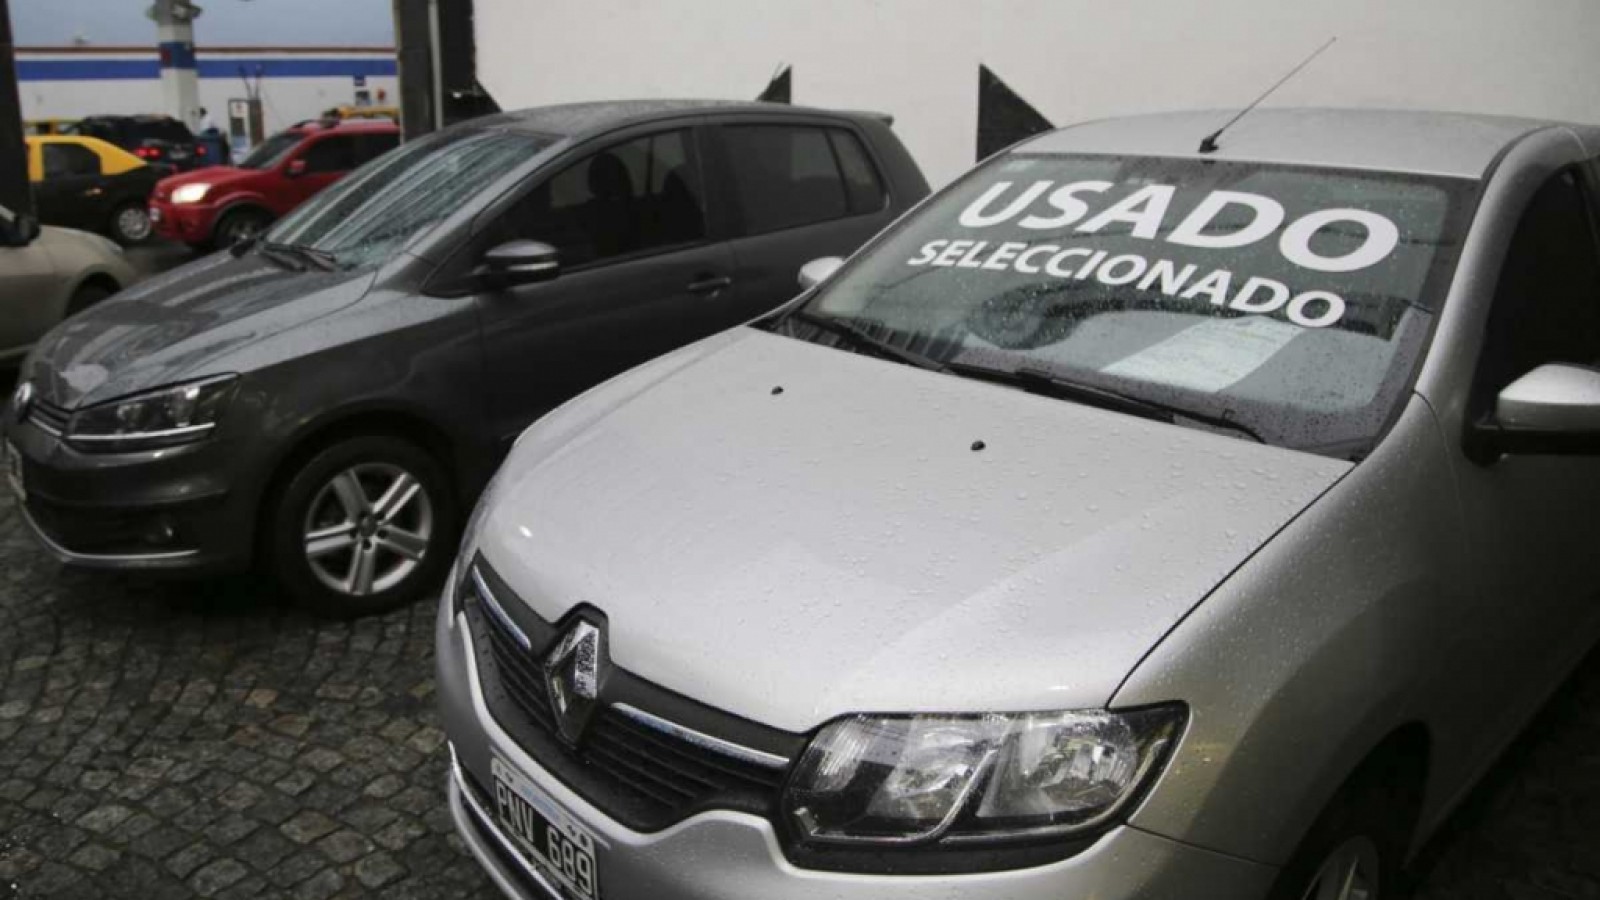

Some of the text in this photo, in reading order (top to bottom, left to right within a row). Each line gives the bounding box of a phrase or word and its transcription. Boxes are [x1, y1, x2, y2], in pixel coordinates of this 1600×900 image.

[958, 179, 1399, 272] USADO
[907, 239, 1345, 328] SELECCIONADO
[496, 780, 534, 842] PNV
[547, 825, 592, 895] 689
